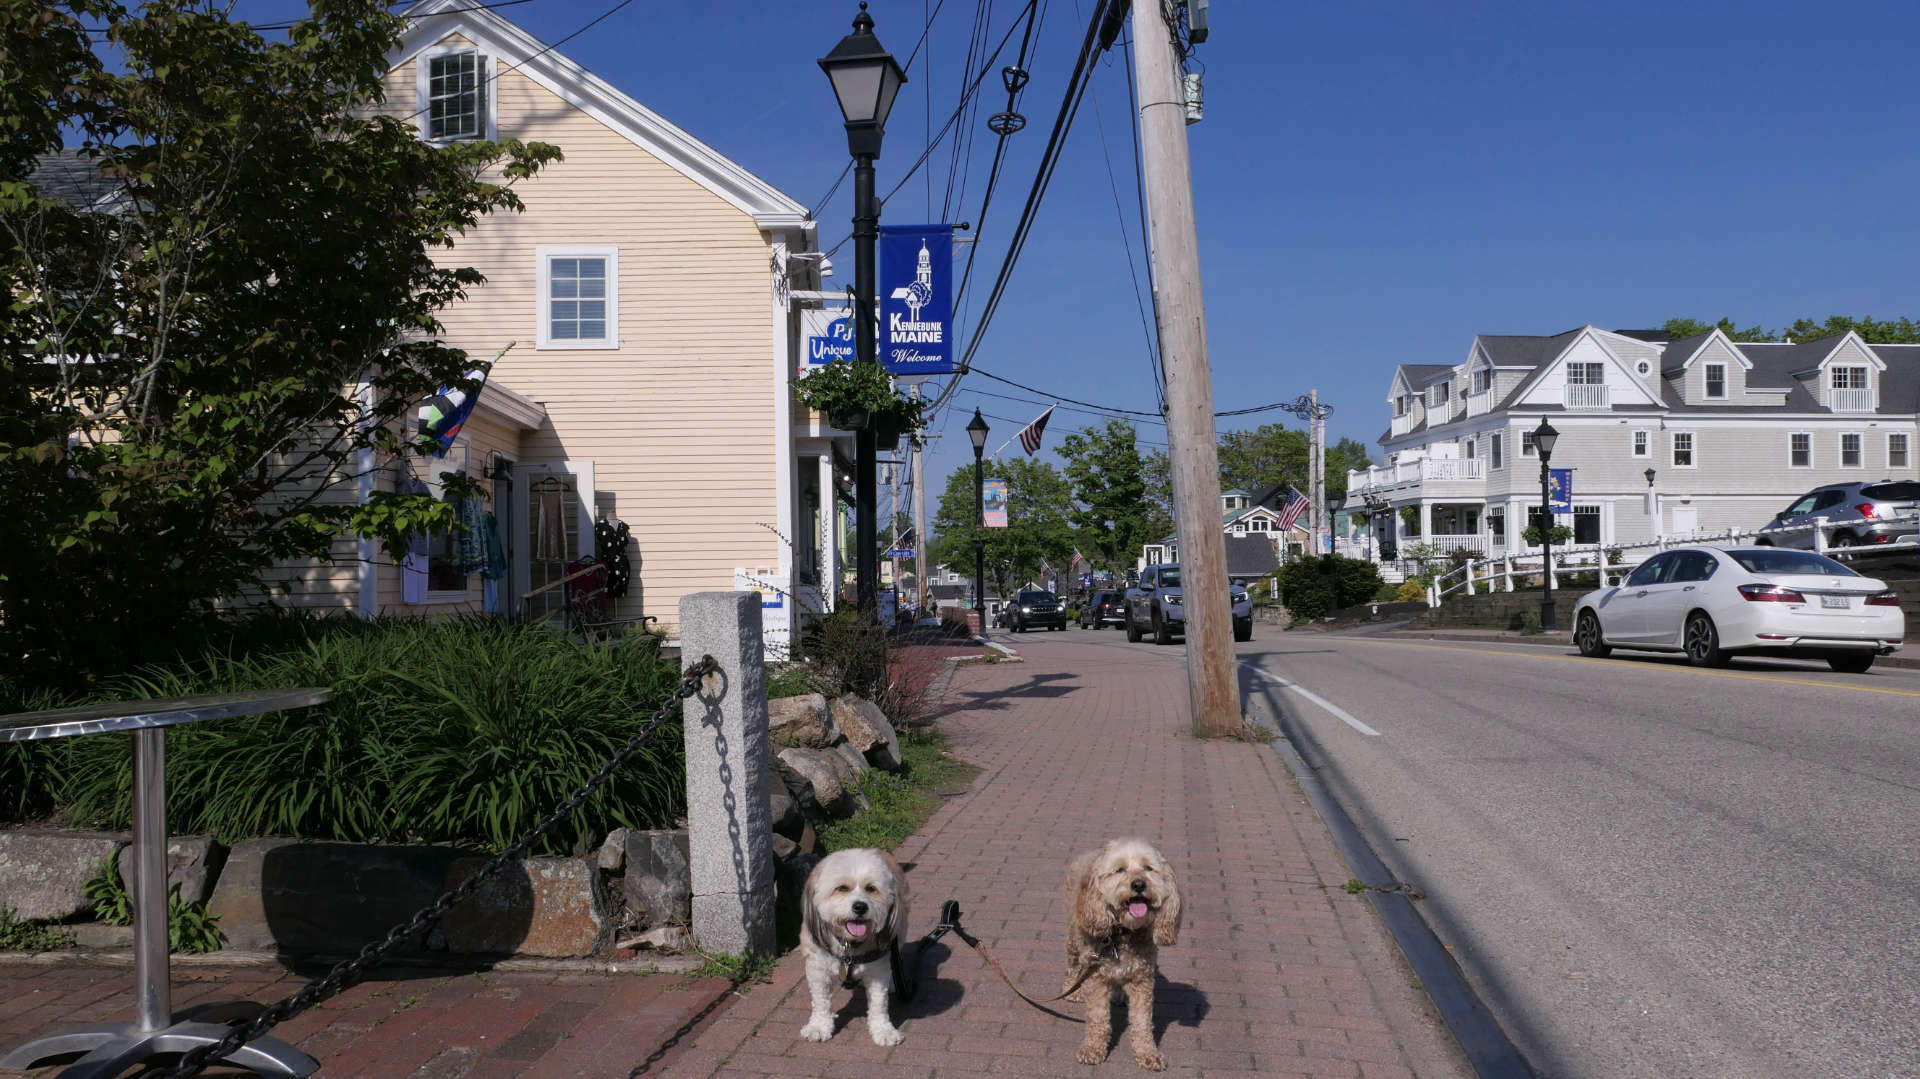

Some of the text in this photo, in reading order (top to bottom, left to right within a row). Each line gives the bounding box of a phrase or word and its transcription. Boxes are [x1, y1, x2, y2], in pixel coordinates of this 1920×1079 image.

[890, 331, 943, 343] MAINE
[811, 339, 853, 360] Unique
[891, 348, 942, 363] Welcome
